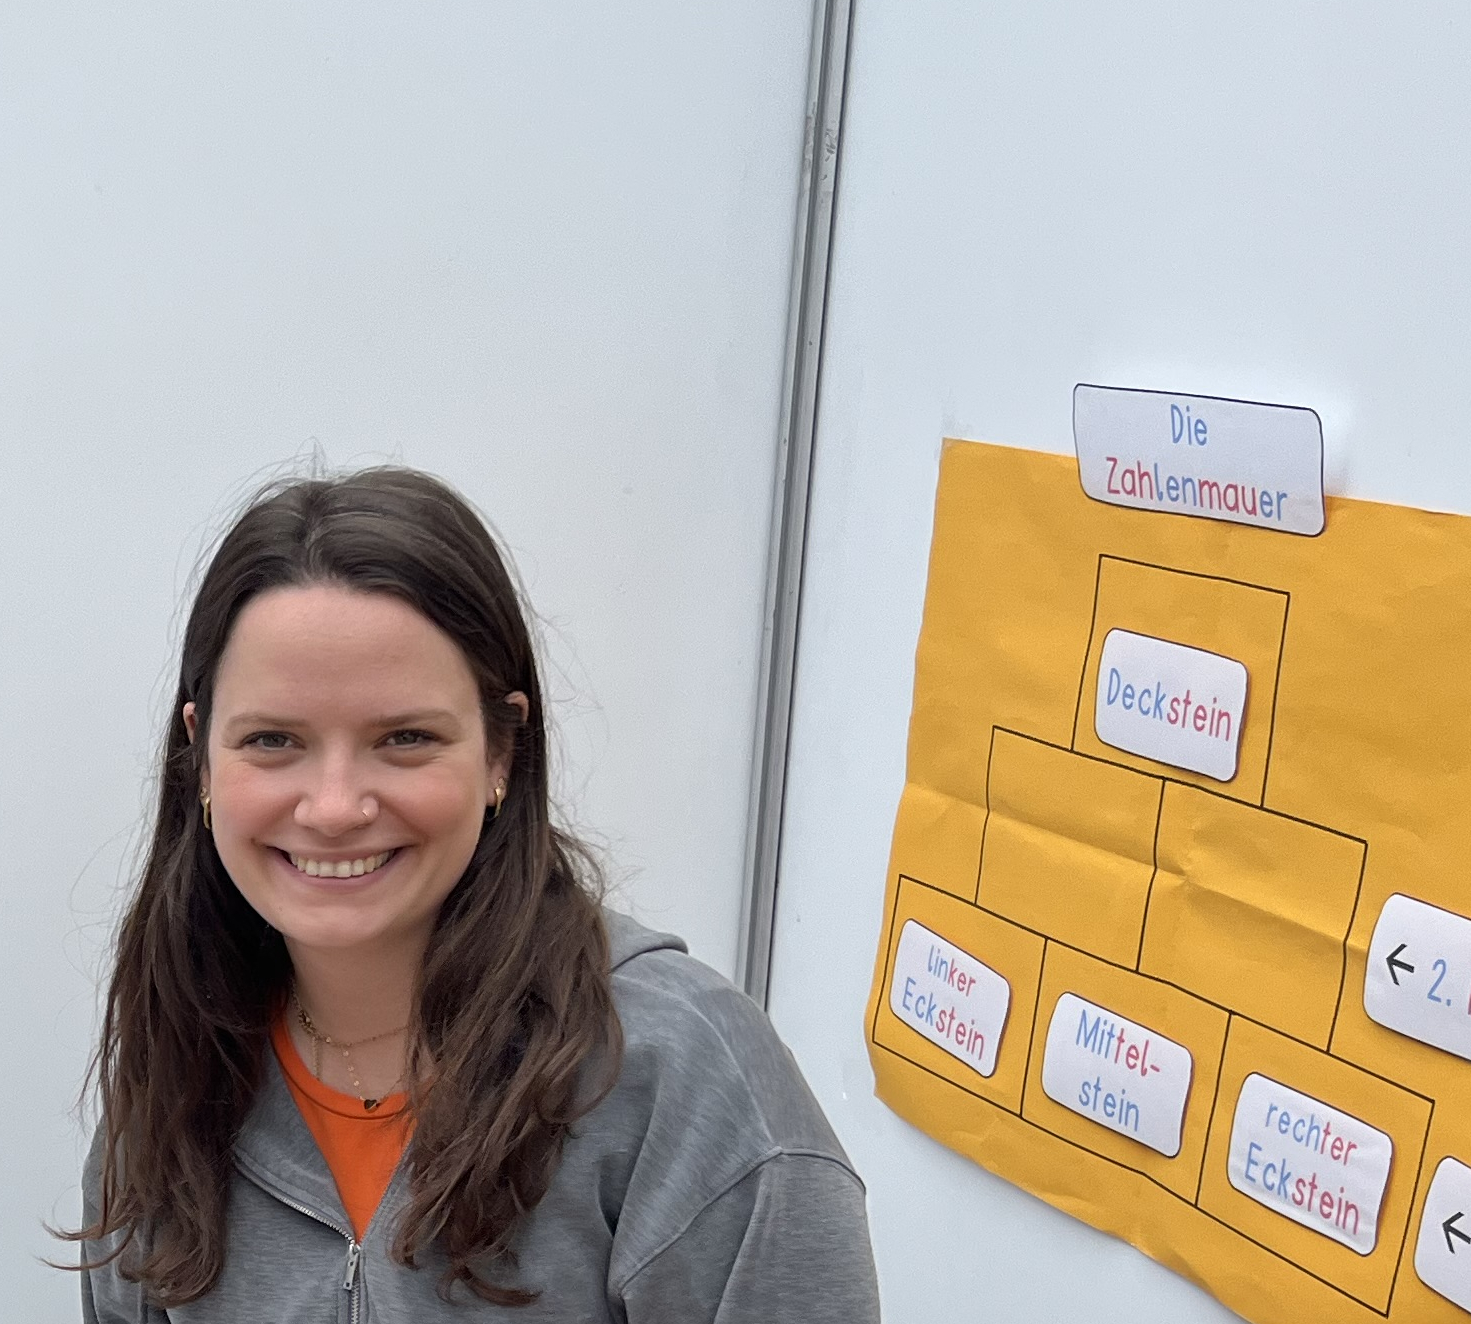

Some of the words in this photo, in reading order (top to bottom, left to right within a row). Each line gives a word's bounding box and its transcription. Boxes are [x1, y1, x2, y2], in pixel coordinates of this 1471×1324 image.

[1170, 404, 1208, 446] Die
[1106, 457, 1287, 521] Zahlenmauer
[1106, 668, 1231, 741] Deckstein
[928, 945, 976, 997] linker
[1427, 959, 1451, 1006] 2.
[902, 977, 985, 1060] Eckstein
[1076, 1010, 1160, 1076] Mittel-
[1079, 1076, 1140, 1132] stein
[1266, 1103, 1357, 1163] rechter
[1246, 1143, 1359, 1235] Eckstein
